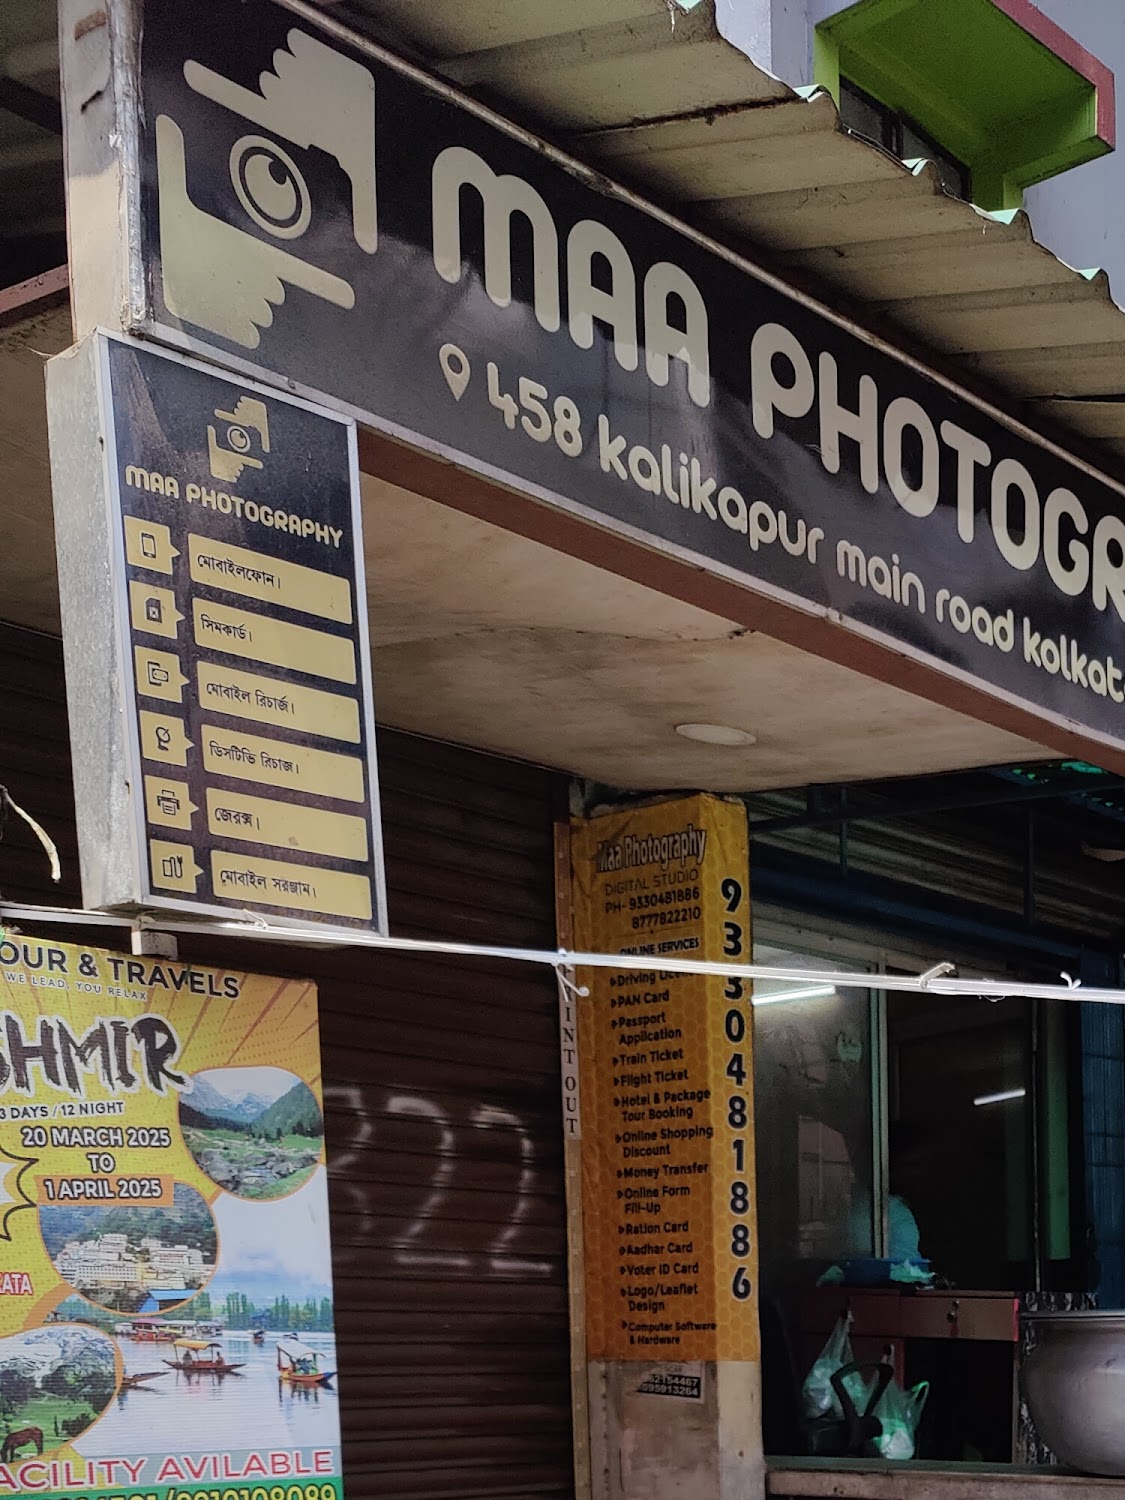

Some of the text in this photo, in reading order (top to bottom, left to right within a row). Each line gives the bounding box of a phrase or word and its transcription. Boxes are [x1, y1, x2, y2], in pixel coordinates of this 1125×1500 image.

[432, 146, 710, 408] MAA
[126, 465, 343, 548] MAA PHOTOGRAPHY
[487, 362, 583, 457] 458
[599, 414, 824, 564] kalikapur
[837, 540, 925, 614] main
[935, 588, 1014, 653] road
[207, 682, 250, 704] মোবাইল
[624, 824, 706, 871] Photography
[220, 868, 267, 890] মোবাইল
[605, 868, 699, 897] DIGITAL STUDIO
[629, 886, 700, 911] 9330481886
[632, 907, 701, 930] 8777822210
[657, 936, 699, 954] SERVICES
[5, 972, 25, 983] WE
[76, 982, 101, 994] YOU
[108, 986, 147, 1001] RELAX
[107, 957, 240, 999] TRAVELS
[619, 1012, 666, 1030] Passport
[619, 1028, 682, 1046] Application
[11, 1102, 124, 1118] DAYS 12 NIGHT
[22, 1126, 171, 1148] 20 MARCH 2025
[87, 1152, 115, 1173] TO
[45, 1178, 162, 1199] 1 APRIL 2025
[158, 1450, 333, 1481] AVILABLE
